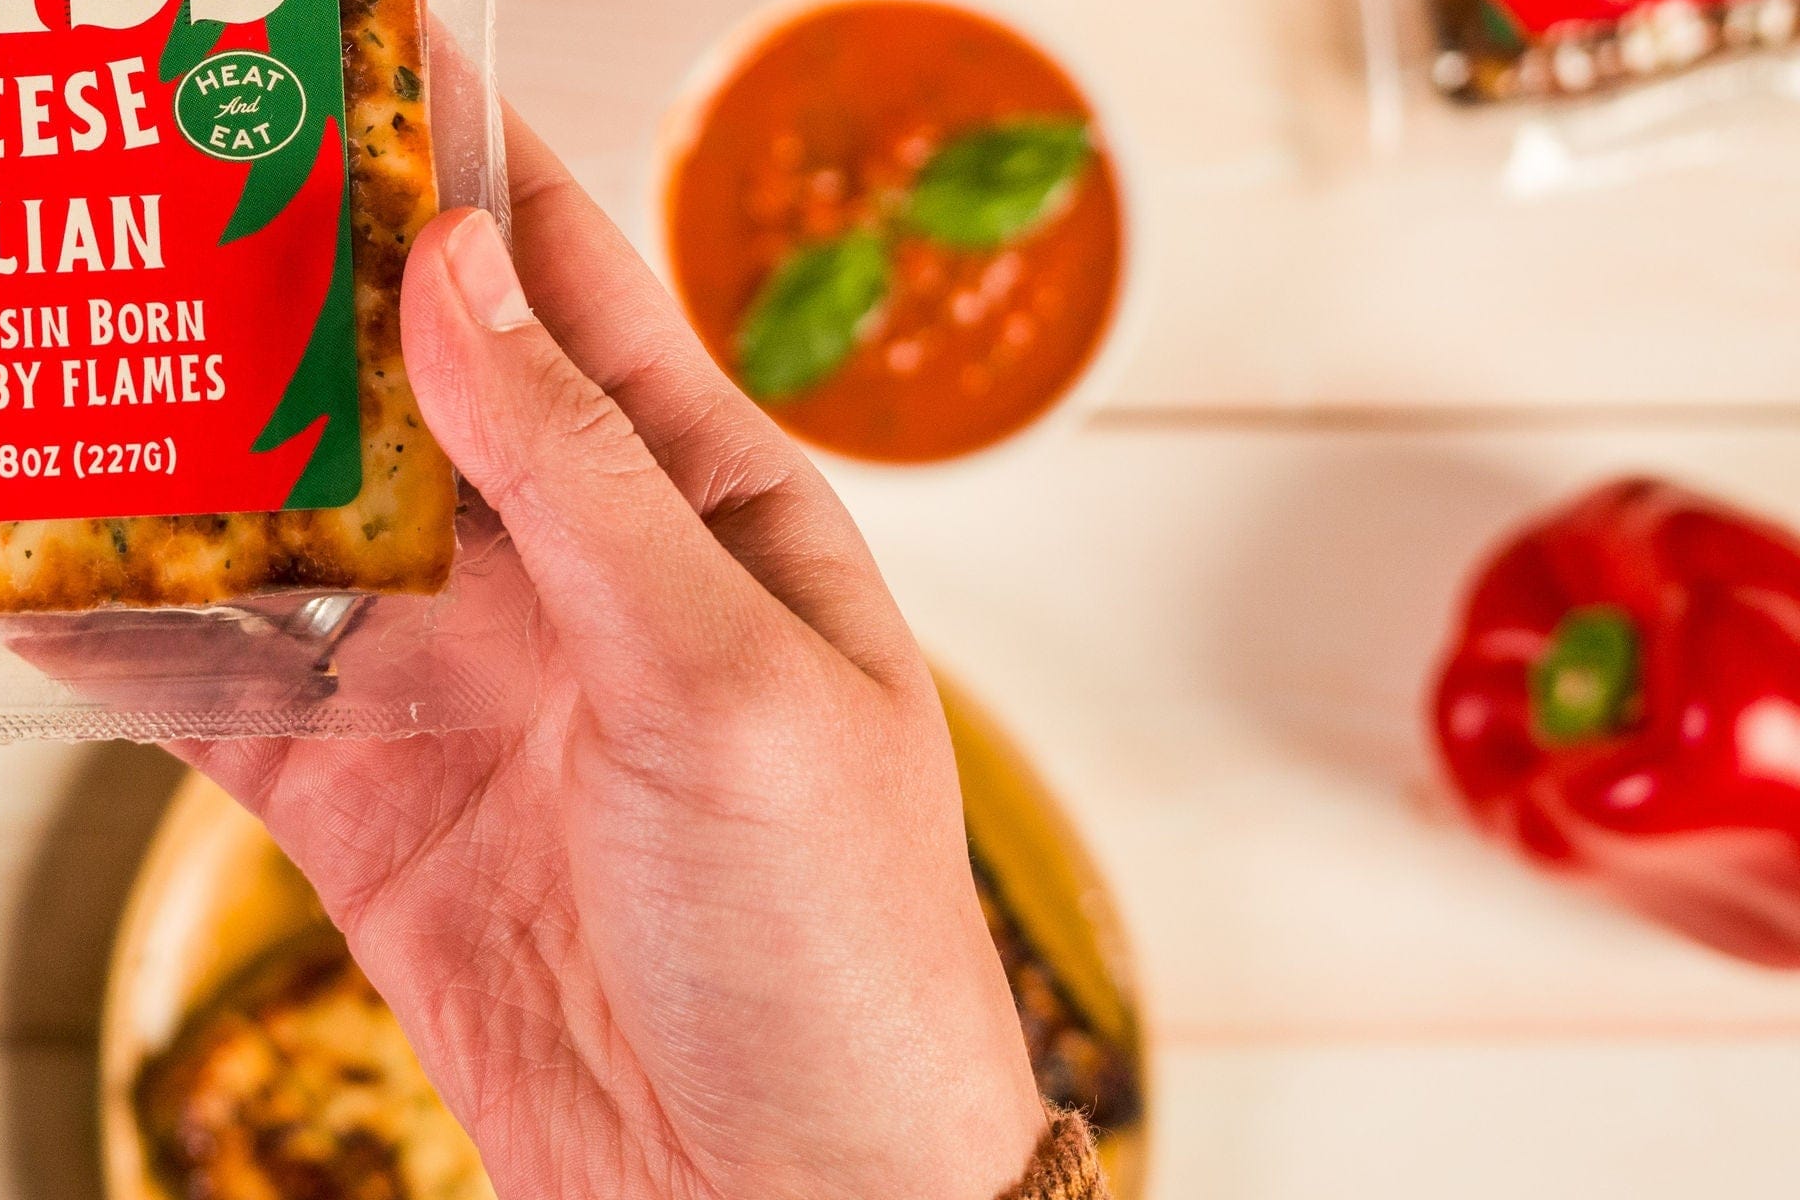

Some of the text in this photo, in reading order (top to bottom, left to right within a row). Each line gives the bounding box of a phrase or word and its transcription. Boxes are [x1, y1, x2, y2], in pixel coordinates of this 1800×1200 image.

[195, 64, 285, 96] HEAT
[213, 95, 261, 119] And
[209, 122, 271, 150] EAT
[88, 299, 206, 346] BORN
[61, 354, 227, 407] FLAMES
[73, 438, 178, 480] (227G)
